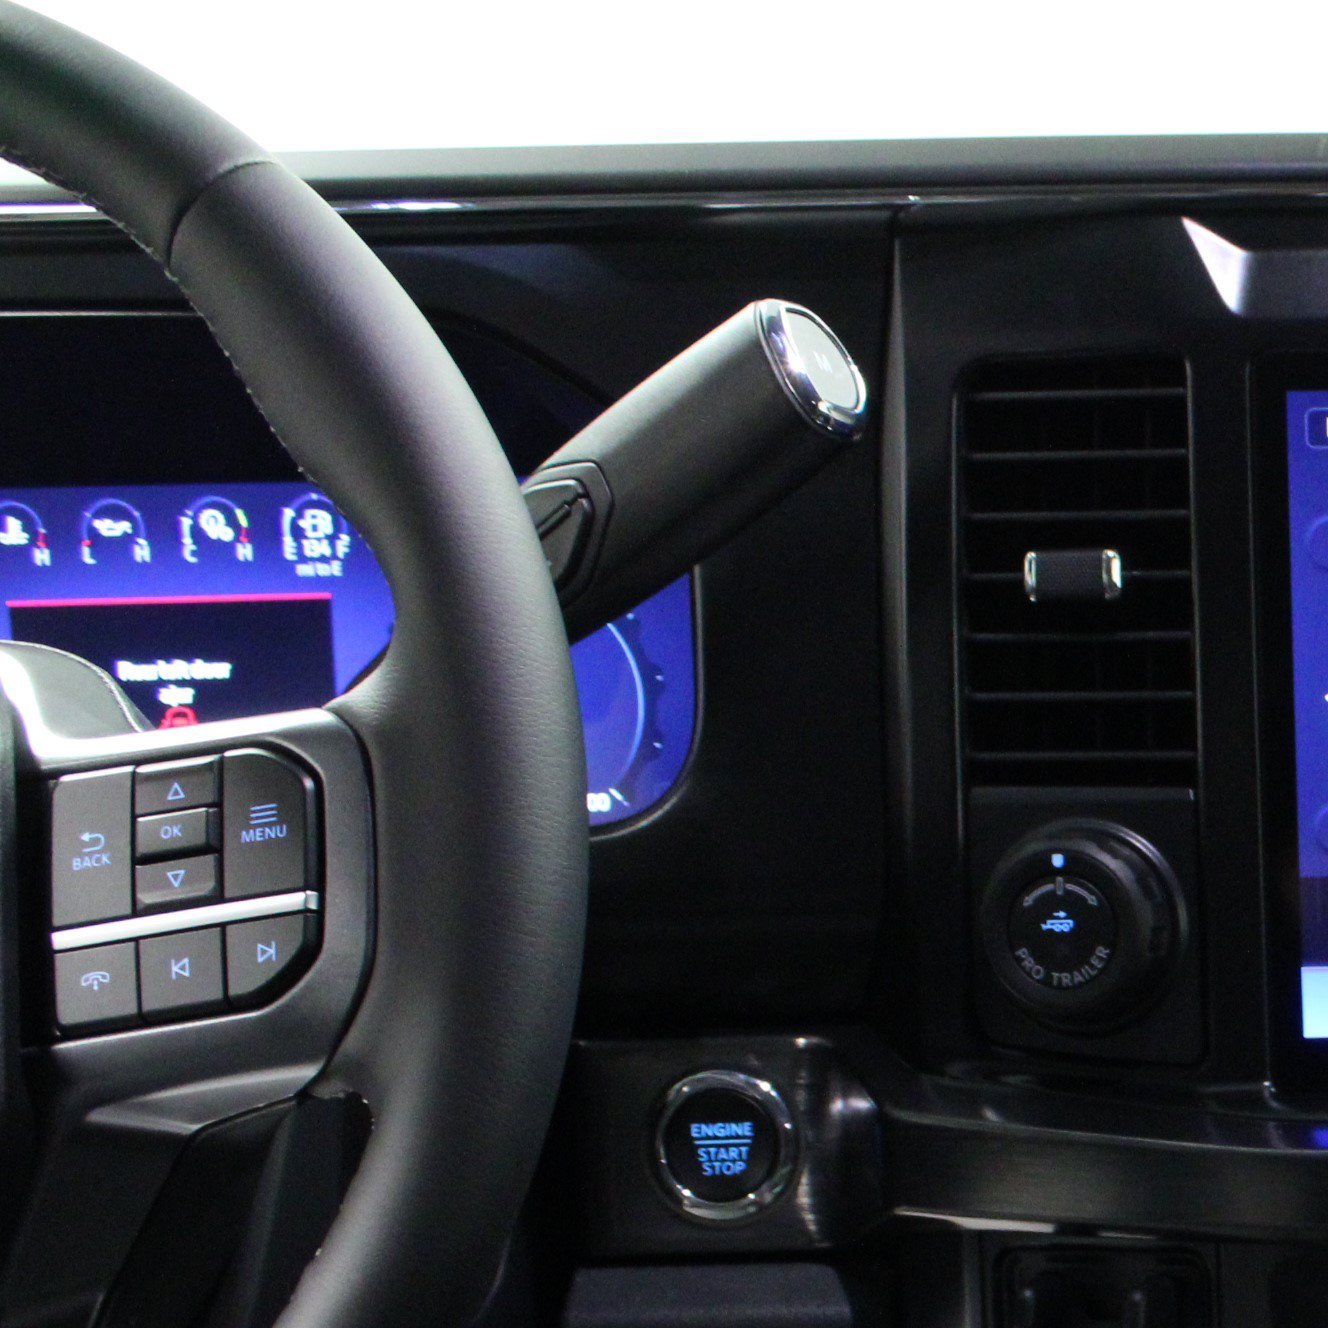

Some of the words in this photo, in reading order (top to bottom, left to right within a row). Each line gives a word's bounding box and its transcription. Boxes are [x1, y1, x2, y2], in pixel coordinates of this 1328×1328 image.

[160, 825, 182, 839] OK
[241, 825, 287, 843] MENU
[72, 853, 111, 871] BACK
[1015, 947, 1045, 979] PRO
[1051, 945, 1111, 987] TRAILER
[690, 1122, 754, 1138] ENGINE
[697, 1146, 749, 1162] START
[702, 1161, 747, 1176] STOP
